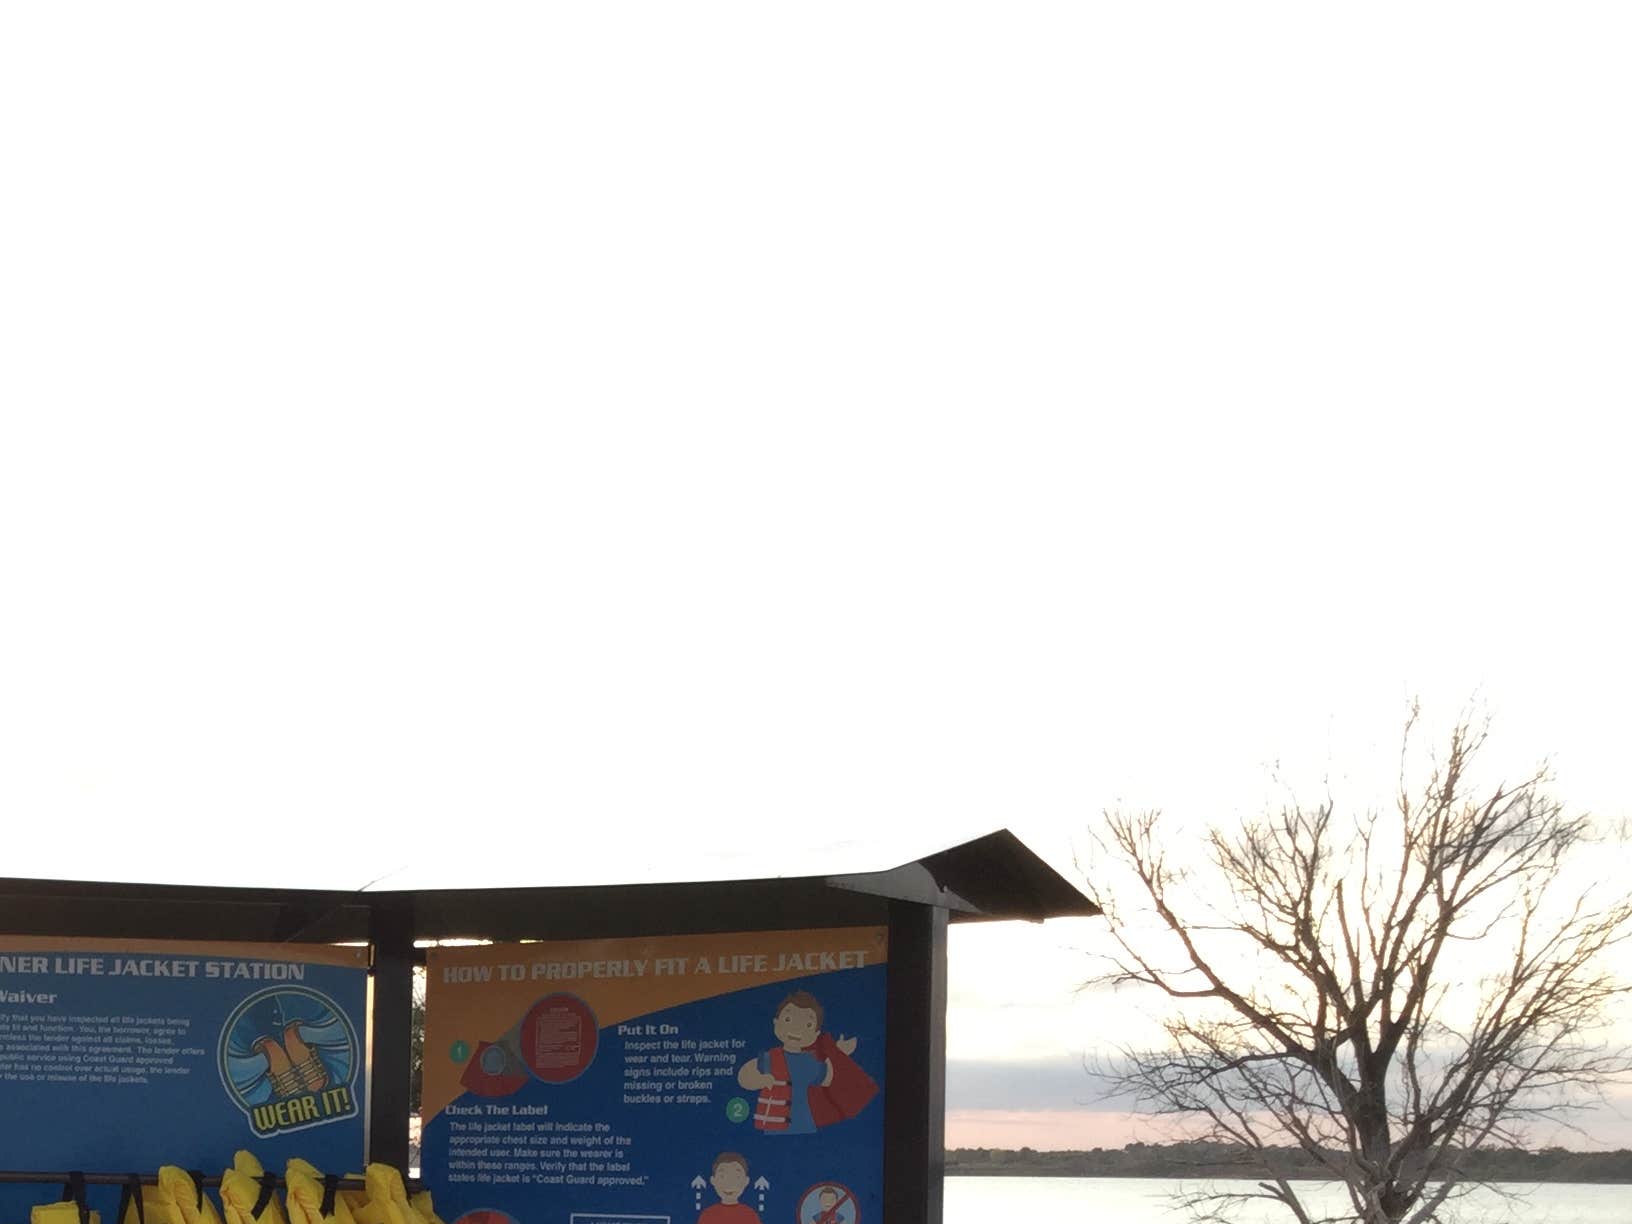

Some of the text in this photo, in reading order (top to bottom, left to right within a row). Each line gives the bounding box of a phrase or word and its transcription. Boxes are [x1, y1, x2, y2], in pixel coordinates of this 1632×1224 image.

[55, 957, 104, 976] LIFE
[108, 958, 199, 978] JACKET
[205, 960, 305, 980] STATION
[443, 950, 869, 984] HOW TO PROPERLY FIT A LIFE JACKET
[618, 1024, 678, 1036] Put It On
[624, 1038, 745, 1052] Inspect the life jacket for
[650, 1054, 668, 1063] and
[694, 1054, 736, 1064] Warning
[624, 1066, 734, 1078] signs include rips and
[624, 1080, 712, 1092] missing or broken
[624, 1094, 661, 1103] buckles
[664, 1095, 674, 1103] or
[254, 1088, 351, 1130] WEAR IT!
[444, 1104, 548, 1116] Check The Label
[734, 1103, 743, 1117] 2
[449, 1122, 610, 1133] The life jacket label will indicate the
[449, 1136, 632, 1147] appropriate chest size and weight of the
